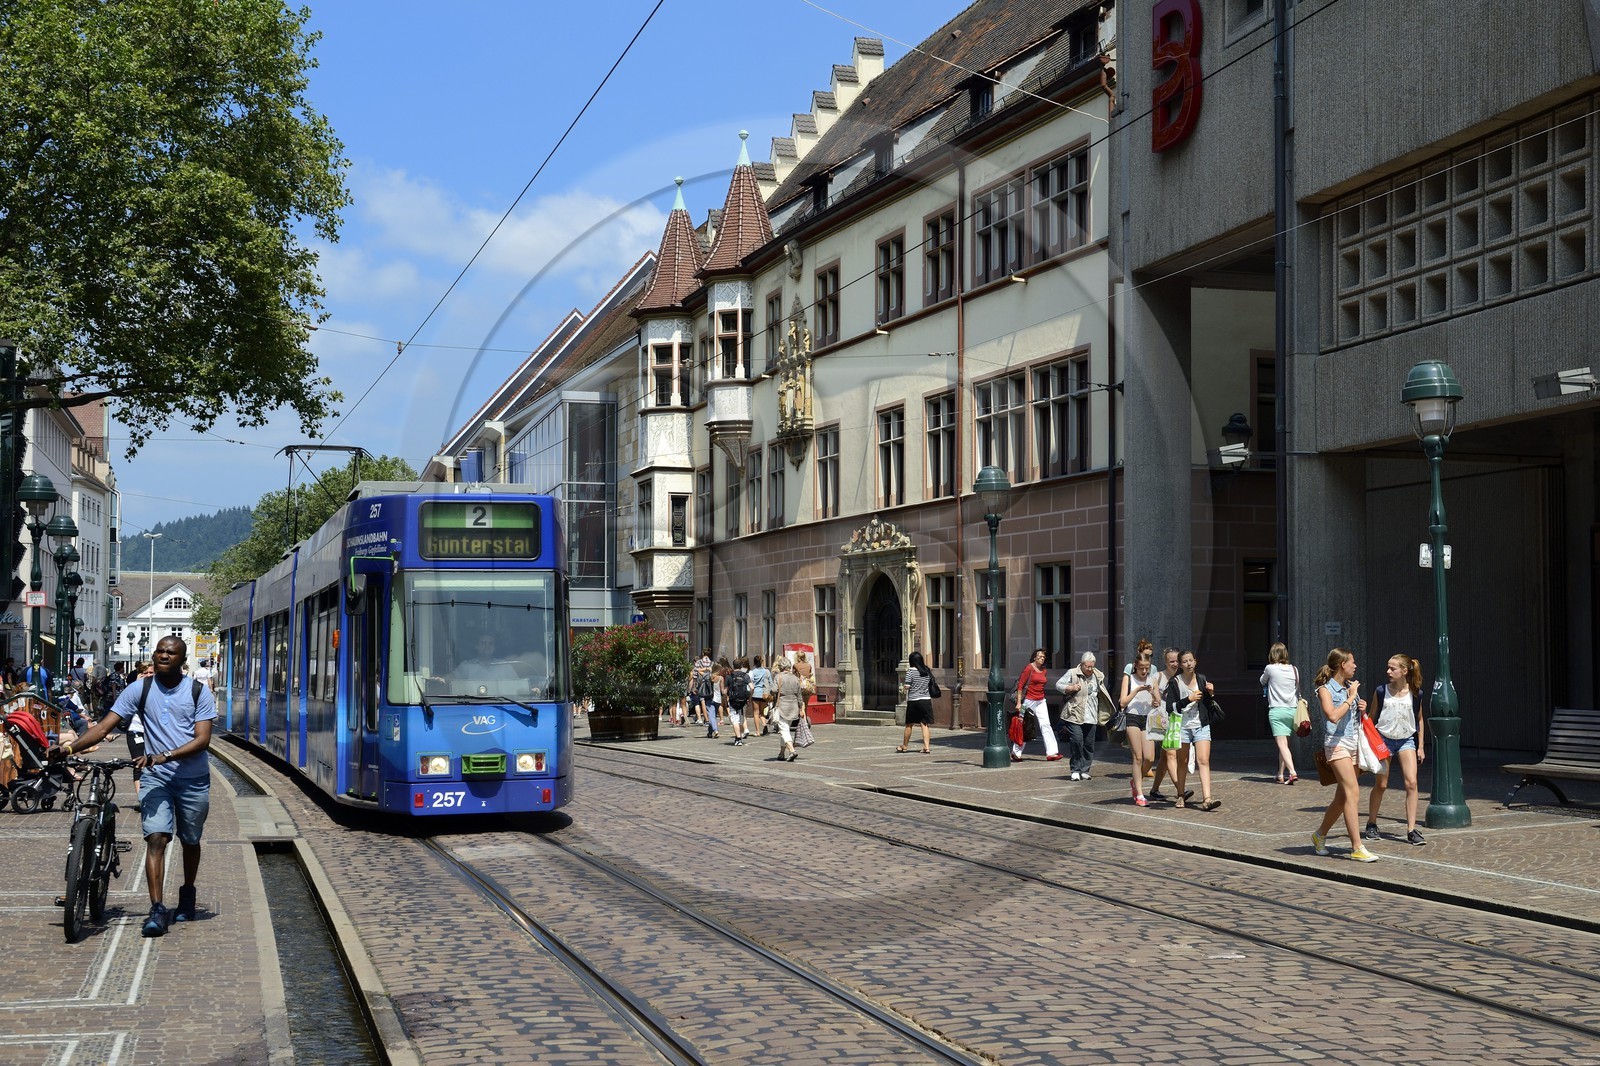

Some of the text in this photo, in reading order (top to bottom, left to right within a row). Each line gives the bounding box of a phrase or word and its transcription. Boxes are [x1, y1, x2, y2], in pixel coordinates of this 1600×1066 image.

[370, 503, 382, 519] 257
[473, 506, 486, 526] 2
[427, 535, 532, 555] Günterstal
[472, 715, 496, 725] VAG
[432, 792, 466, 808] 257
